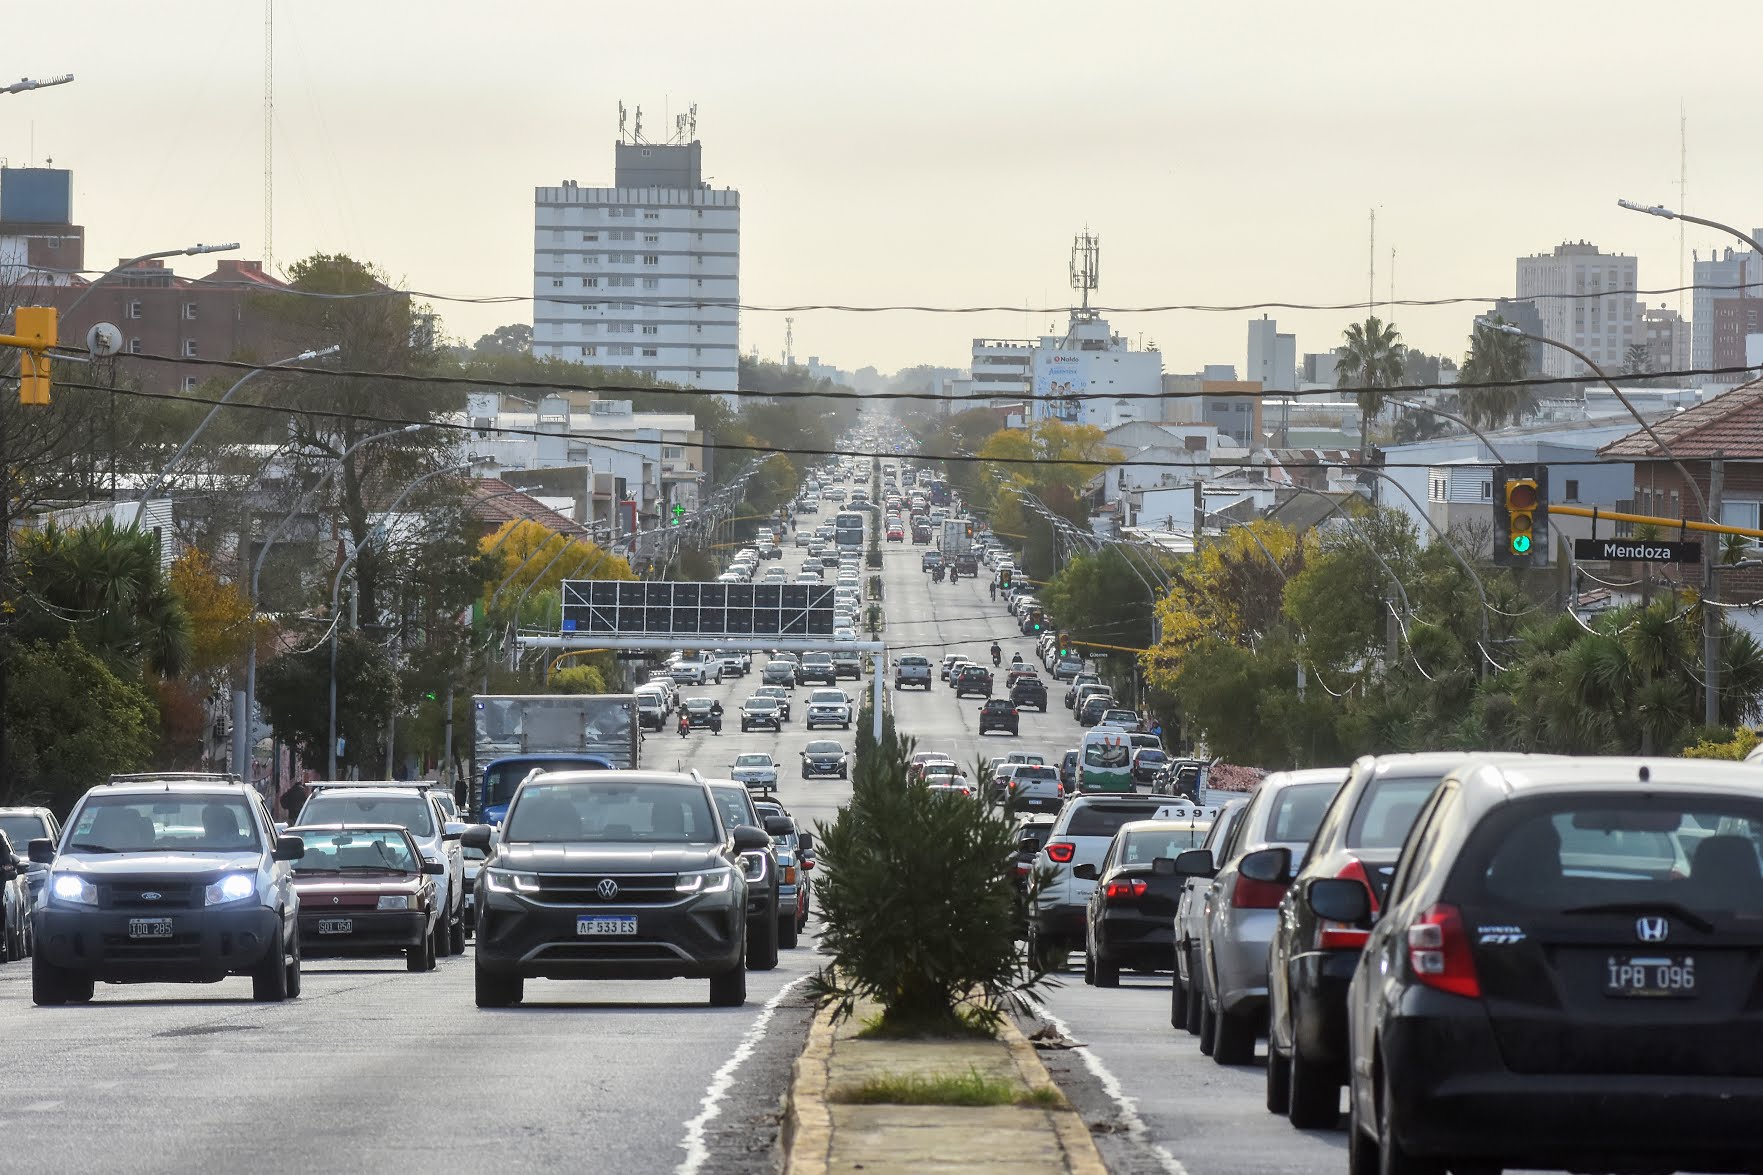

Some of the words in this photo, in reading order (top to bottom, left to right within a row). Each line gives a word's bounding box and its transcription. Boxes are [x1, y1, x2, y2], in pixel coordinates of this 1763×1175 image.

[1604, 543, 1671, 559] Mendoza
[1162, 809, 1217, 817] 1391
[580, 922, 593, 933] AF
[597, 922, 617, 933] 533
[620, 922, 634, 933] ES
[1608, 966, 1645, 988] IPB
[1657, 966, 1695, 988] 096
